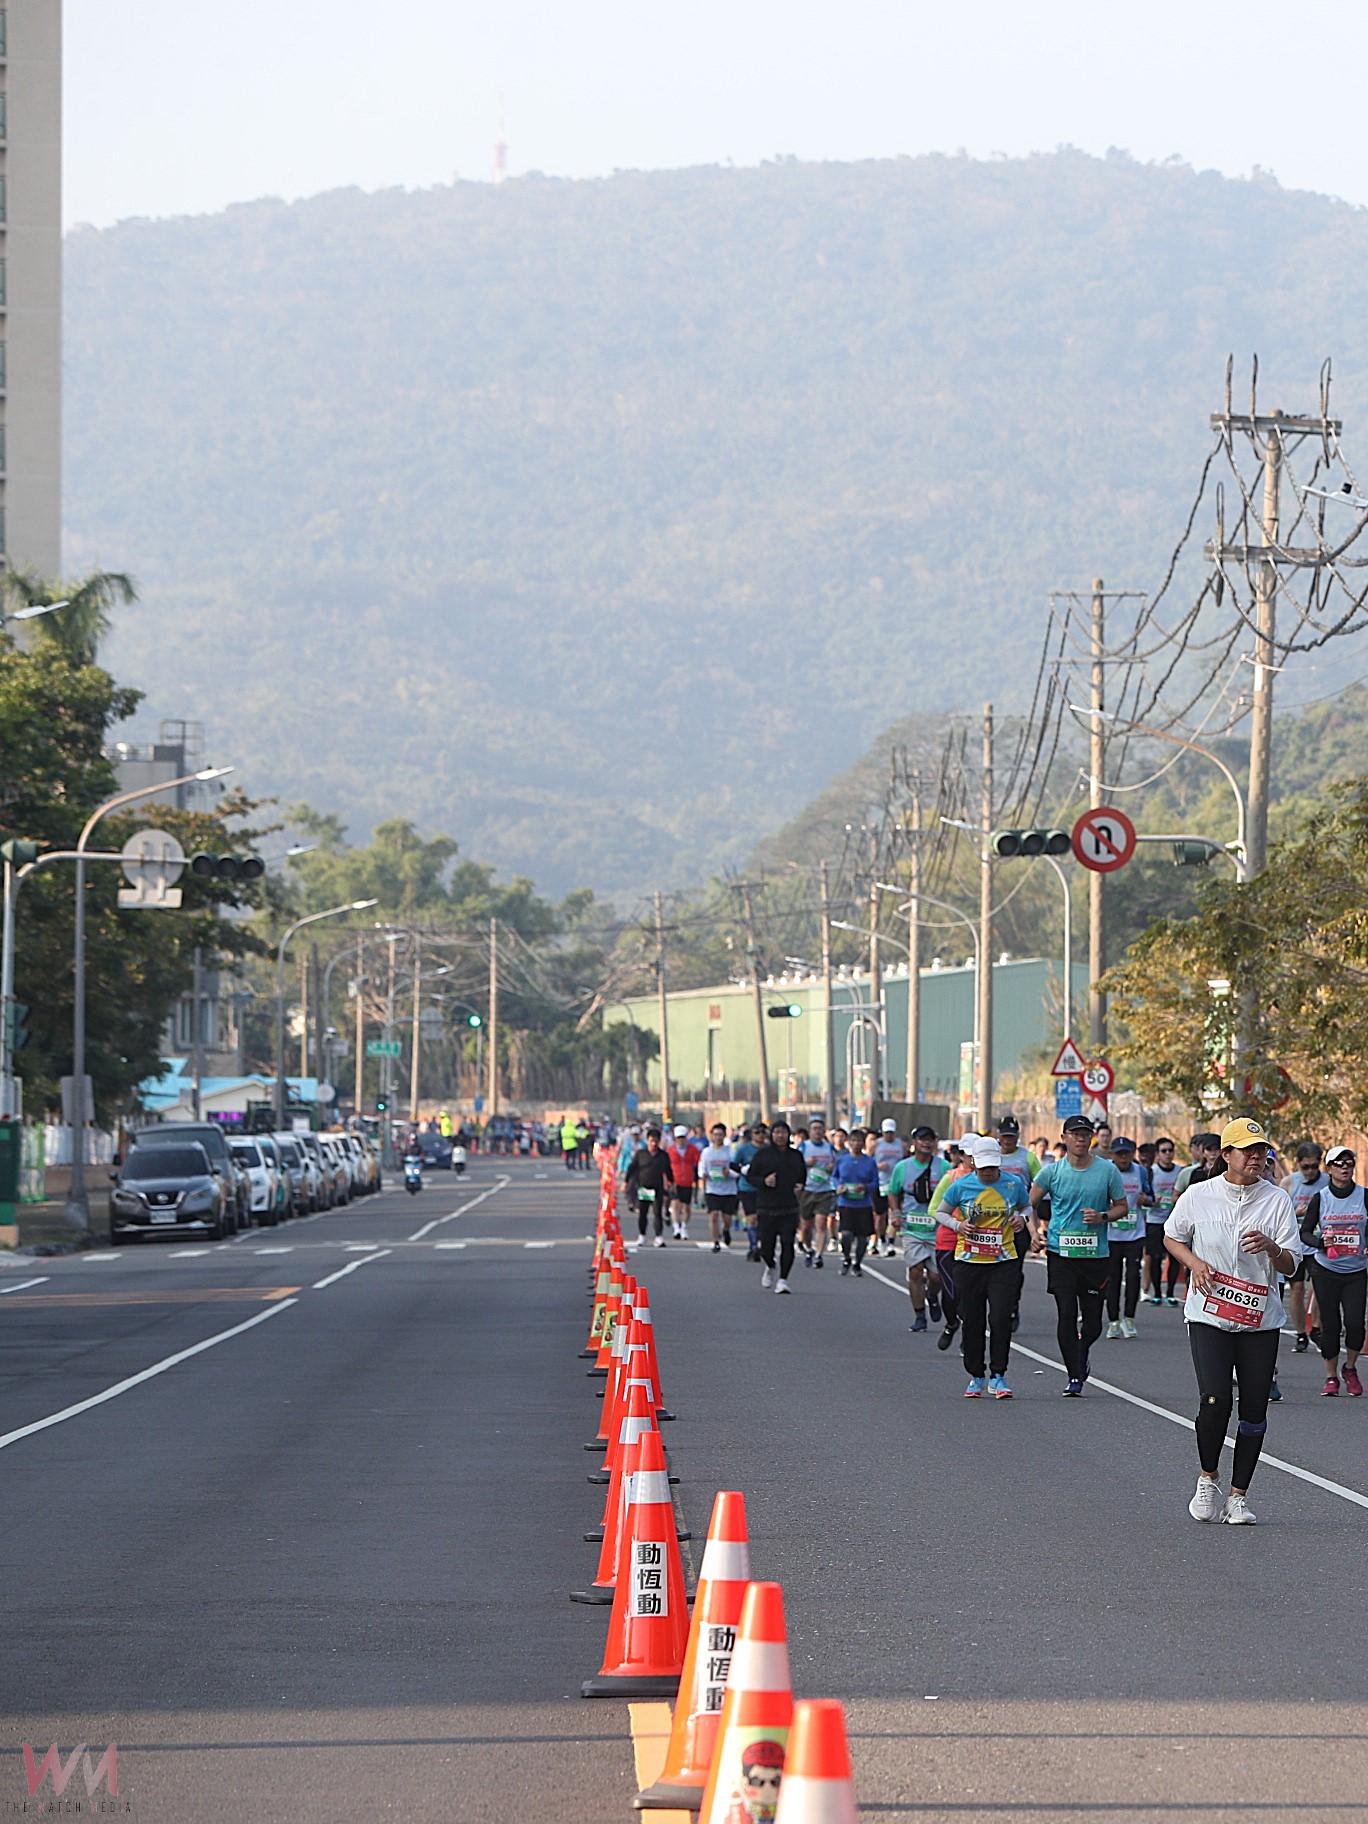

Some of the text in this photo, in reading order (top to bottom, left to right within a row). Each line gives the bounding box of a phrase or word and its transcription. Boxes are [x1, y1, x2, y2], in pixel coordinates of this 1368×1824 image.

[1087, 1071, 1106, 1085] 50
[1057, 1081, 1068, 1093] P
[971, 1234, 997, 1244] 0899
[1064, 1237, 1093, 1245] 30384
[1216, 1286, 1260, 1308] 40636
